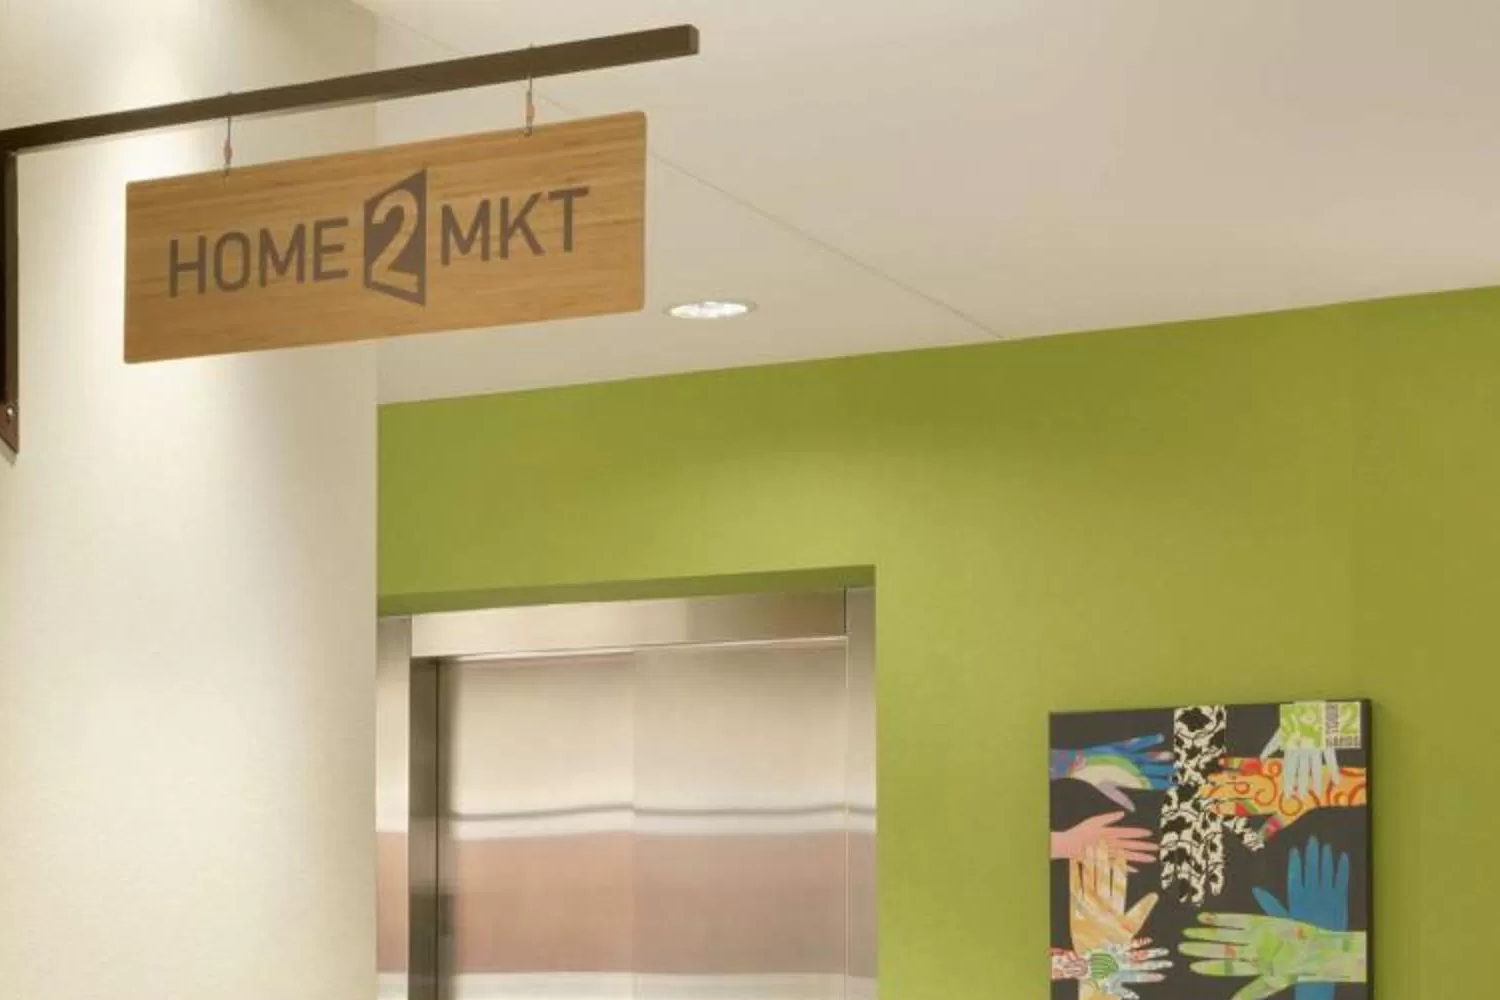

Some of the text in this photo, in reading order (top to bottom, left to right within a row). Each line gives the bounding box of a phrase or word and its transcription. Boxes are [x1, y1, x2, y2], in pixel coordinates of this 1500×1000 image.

[168, 186, 590, 298] HOME 2 MKT
